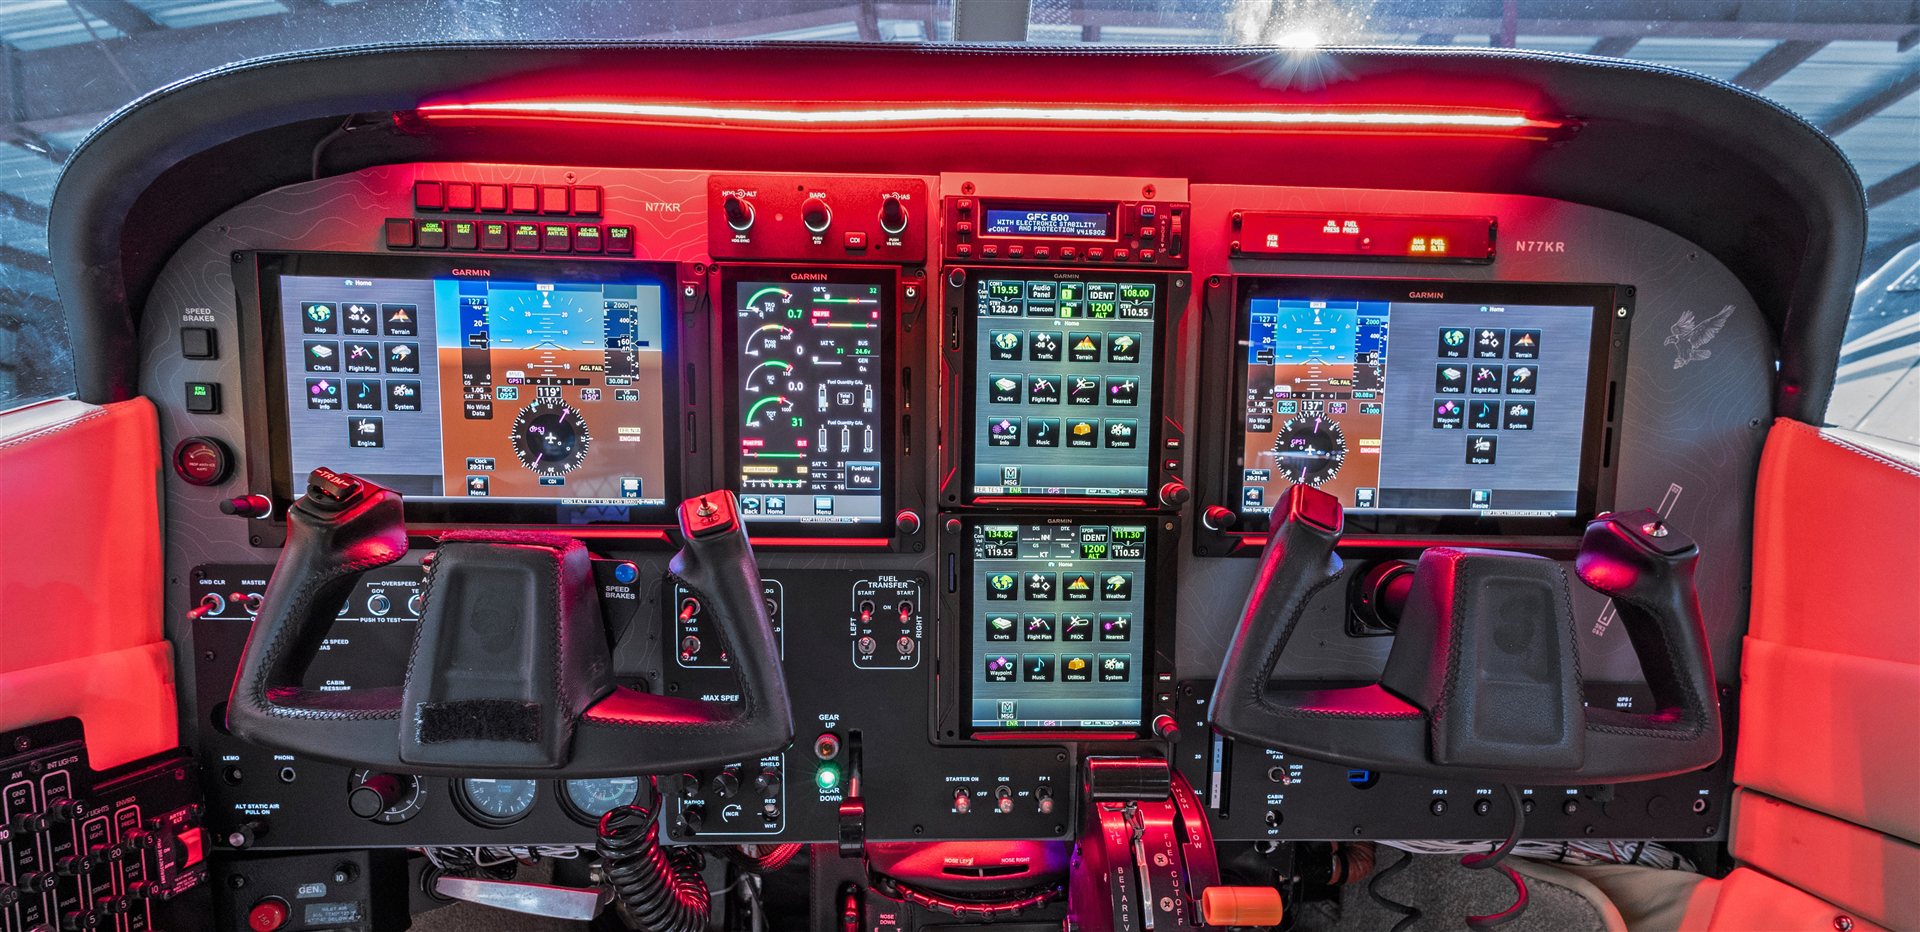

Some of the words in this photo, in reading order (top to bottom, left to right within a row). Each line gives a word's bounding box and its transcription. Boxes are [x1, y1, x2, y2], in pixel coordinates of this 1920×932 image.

[646, 202, 680, 212] N77KR
[1516, 241, 1565, 252] N77KR
[992, 286, 1018, 294] 119.55
[1090, 292, 1114, 300] IDENT
[1409, 291, 1443, 299] GARMIN
[1091, 304, 1112, 312] 1200
[788, 310, 802, 318] 0.7
[788, 382, 803, 390] 0.0
[538, 388, 560, 397] 119°
[1302, 402, 1322, 410] 137°
[792, 418, 803, 427] 31
[988, 530, 1013, 538] 134.82
[1083, 534, 1106, 542] IDENT
[1115, 531, 1140, 539] 111.30
[1084, 545, 1105, 553] 1200
[1115, 549, 1139, 557] 110.55
[1165, 834, 1174, 865] FUEL
[299, 886, 322, 894] GEN.
[1171, 871, 1183, 925] CUTOFF
